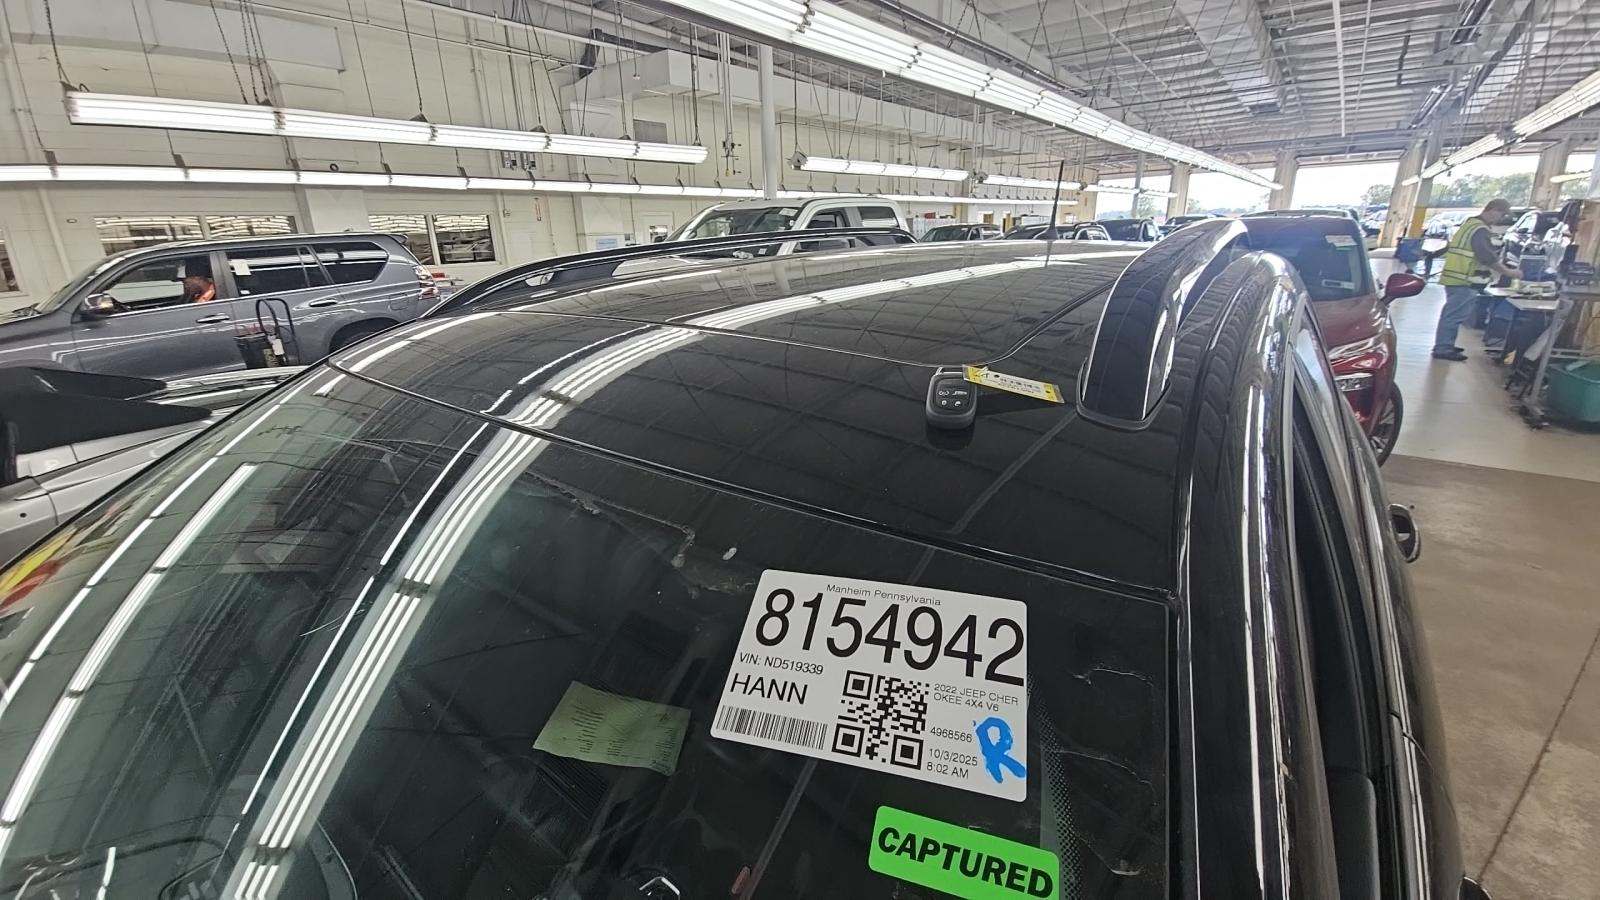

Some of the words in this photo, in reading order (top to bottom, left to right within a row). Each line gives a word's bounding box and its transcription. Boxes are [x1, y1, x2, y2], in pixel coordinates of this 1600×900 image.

[826, 584, 871, 597] Manheim
[874, 589, 942, 606] Pennsylvania
[755, 588, 1025, 688] 8154942
[740, 651, 761, 666] VIN:
[764, 656, 824, 675] ND519339
[730, 672, 808, 705] HANN
[934, 683, 957, 695] 2022
[960, 687, 987, 699] JEEP
[988, 692, 1019, 706] CHER
[933, 692, 962, 705] OKEE
[965, 698, 983, 709] 4X4
[986, 701, 999, 712] V6
[930, 726, 973, 743] 4968566
[929, 748, 978, 767] 10/3/2025
[976, 717, 1026, 784] R
[926, 761, 949, 775] 8:02
[951, 766, 969, 780] AM
[878, 827, 1054, 899] CAPTURED
